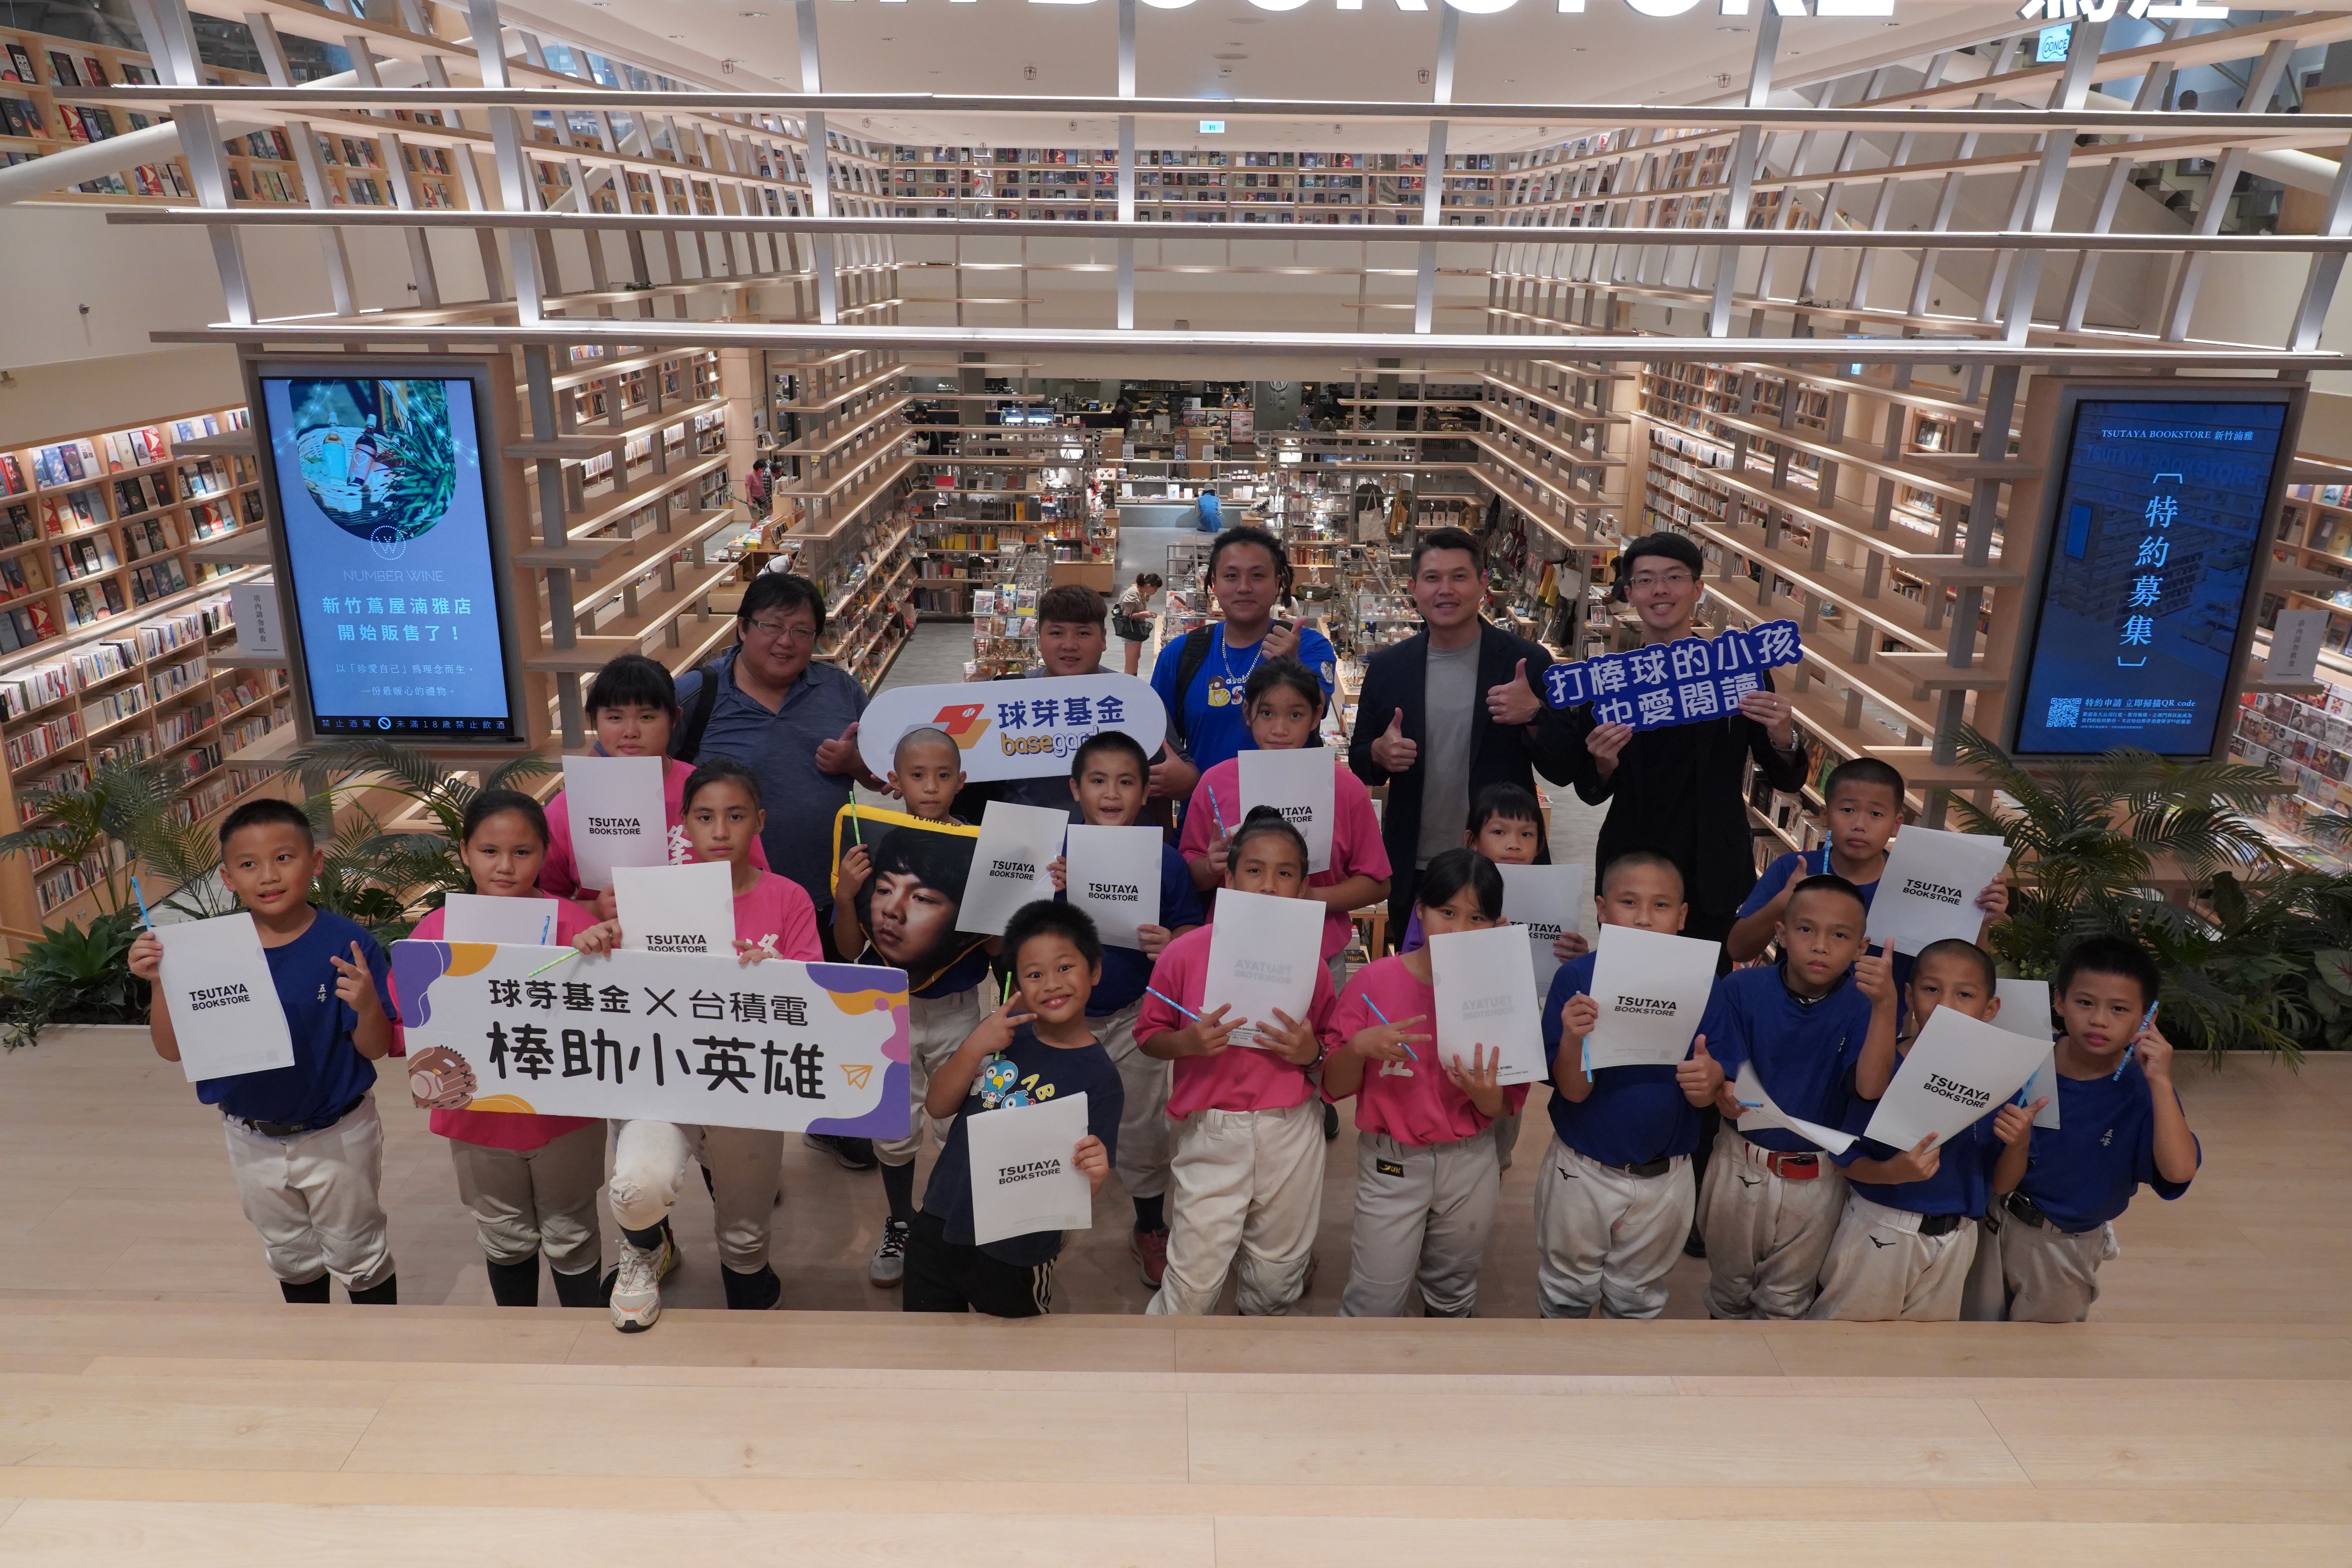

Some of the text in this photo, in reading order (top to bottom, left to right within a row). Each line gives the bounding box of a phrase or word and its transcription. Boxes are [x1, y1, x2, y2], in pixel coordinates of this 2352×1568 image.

[2102, 429, 2254, 441] TSUTAYA BOOKSTORE 新竹湳雅
[343, 570, 445, 583] NUMBER WINE
[322, 597, 472, 615] 新竹蔦屋湳雅店
[1549, 626, 1798, 704] 打棒球的小孩
[1598, 672, 1759, 727] 也愛閱讀
[2085, 698, 2123, 708] 特約申請
[998, 695, 1125, 729] 球芽基金
[321, 719, 505, 730] 禁止酒駕 未滿18歲禁止飲酒
[1278, 806, 1312, 816] UTAYA
[588, 817, 640, 827] TSUTAYA
[989, 870, 1034, 881] BOOKSTORE
[993, 860, 1035, 873] TSUTAYA
[1088, 892, 1138, 902] BOOKSTORE
[1089, 883, 1139, 894] TSUTAYA
[1903, 887, 1961, 906] BOOKSTORE
[1907, 879, 1962, 898] TSUTAYA
[646, 935, 706, 944] TSUTAYA
[189, 984, 248, 1002] TSUTAYA
[317, 984, 327, 1002] 五峰
[192, 994, 250, 1011] BOOKSTORE
[489, 978, 632, 1014] 球芽基金
[691, 988, 808, 1027] 台積電
[1614, 1005, 1675, 1017] BOOKSTORE
[1617, 996, 1677, 1010] TSUTAYA
[486, 1021, 826, 1100] 棒助小英雄
[1923, 1082, 1987, 1109] BOOKSTORE
[1929, 1073, 1991, 1102] TSUTAYA
[2100, 1129, 2112, 1147] 五峰
[998, 1159, 1061, 1177] TSUTAYA
[999, 1167, 1061, 1185] BOOKSTORE
